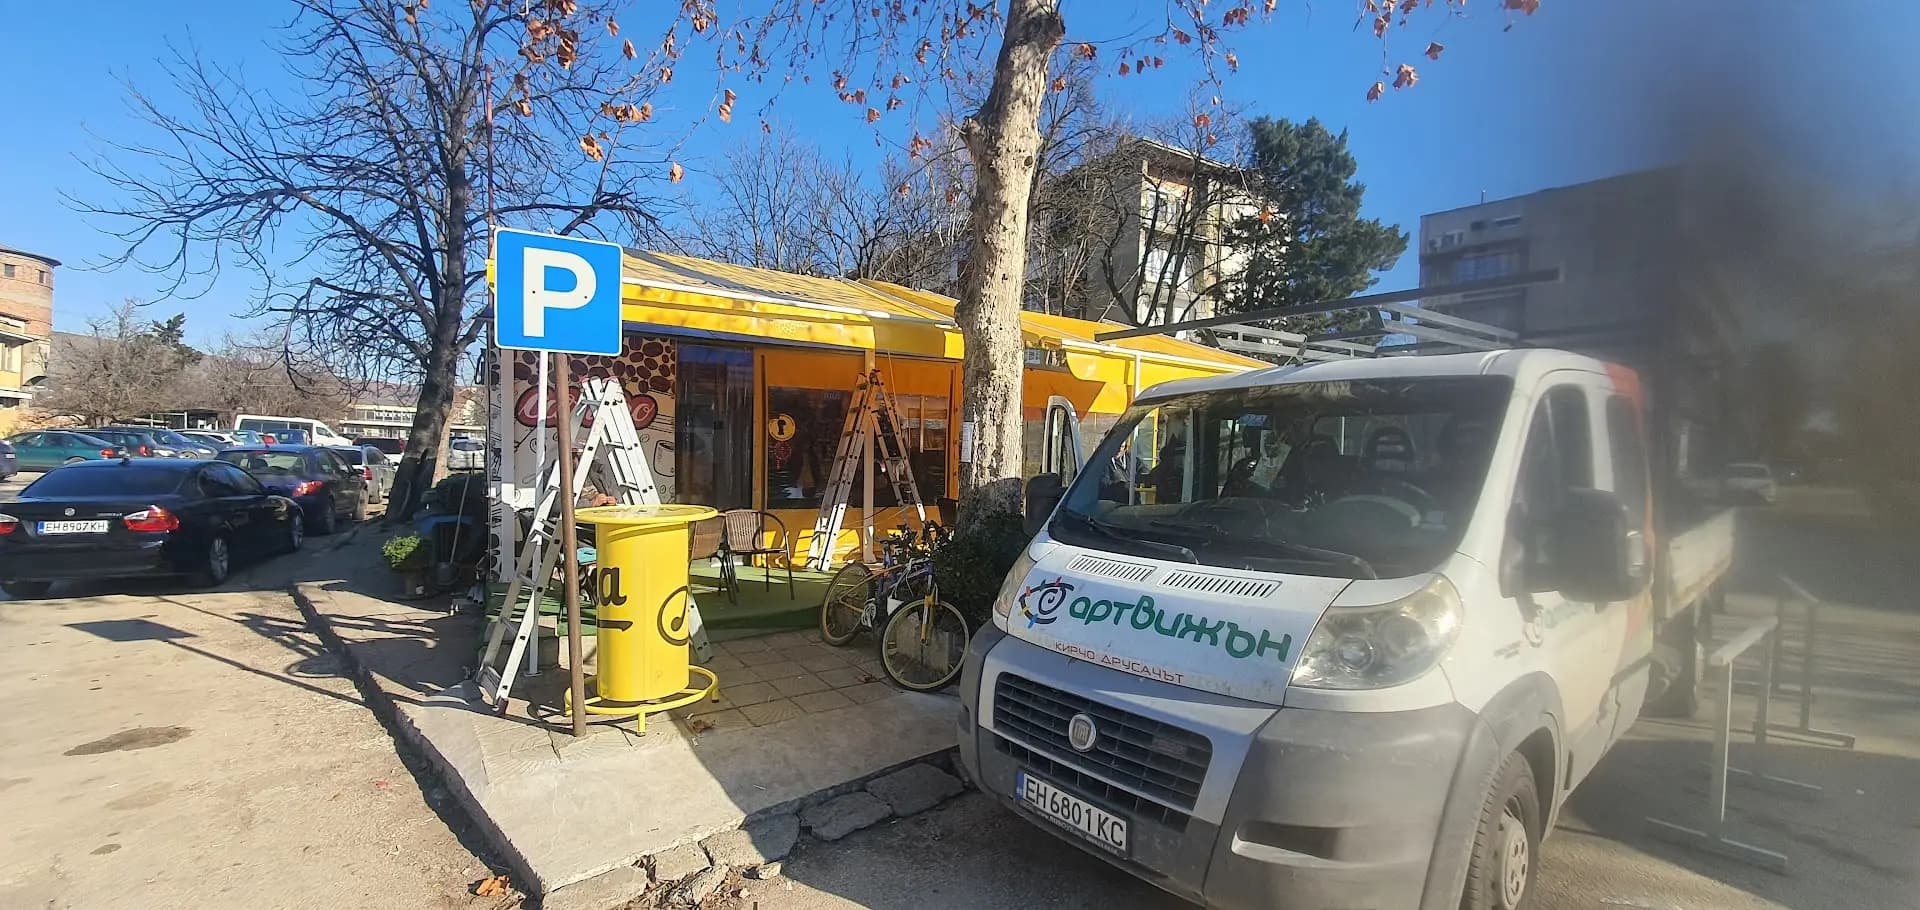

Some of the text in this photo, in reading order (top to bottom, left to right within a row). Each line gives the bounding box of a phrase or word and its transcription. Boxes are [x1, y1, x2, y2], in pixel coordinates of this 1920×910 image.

[523, 246, 597, 337] P
[1055, 641, 1185, 684] КИРЧО ДРУСАЧЪТ
